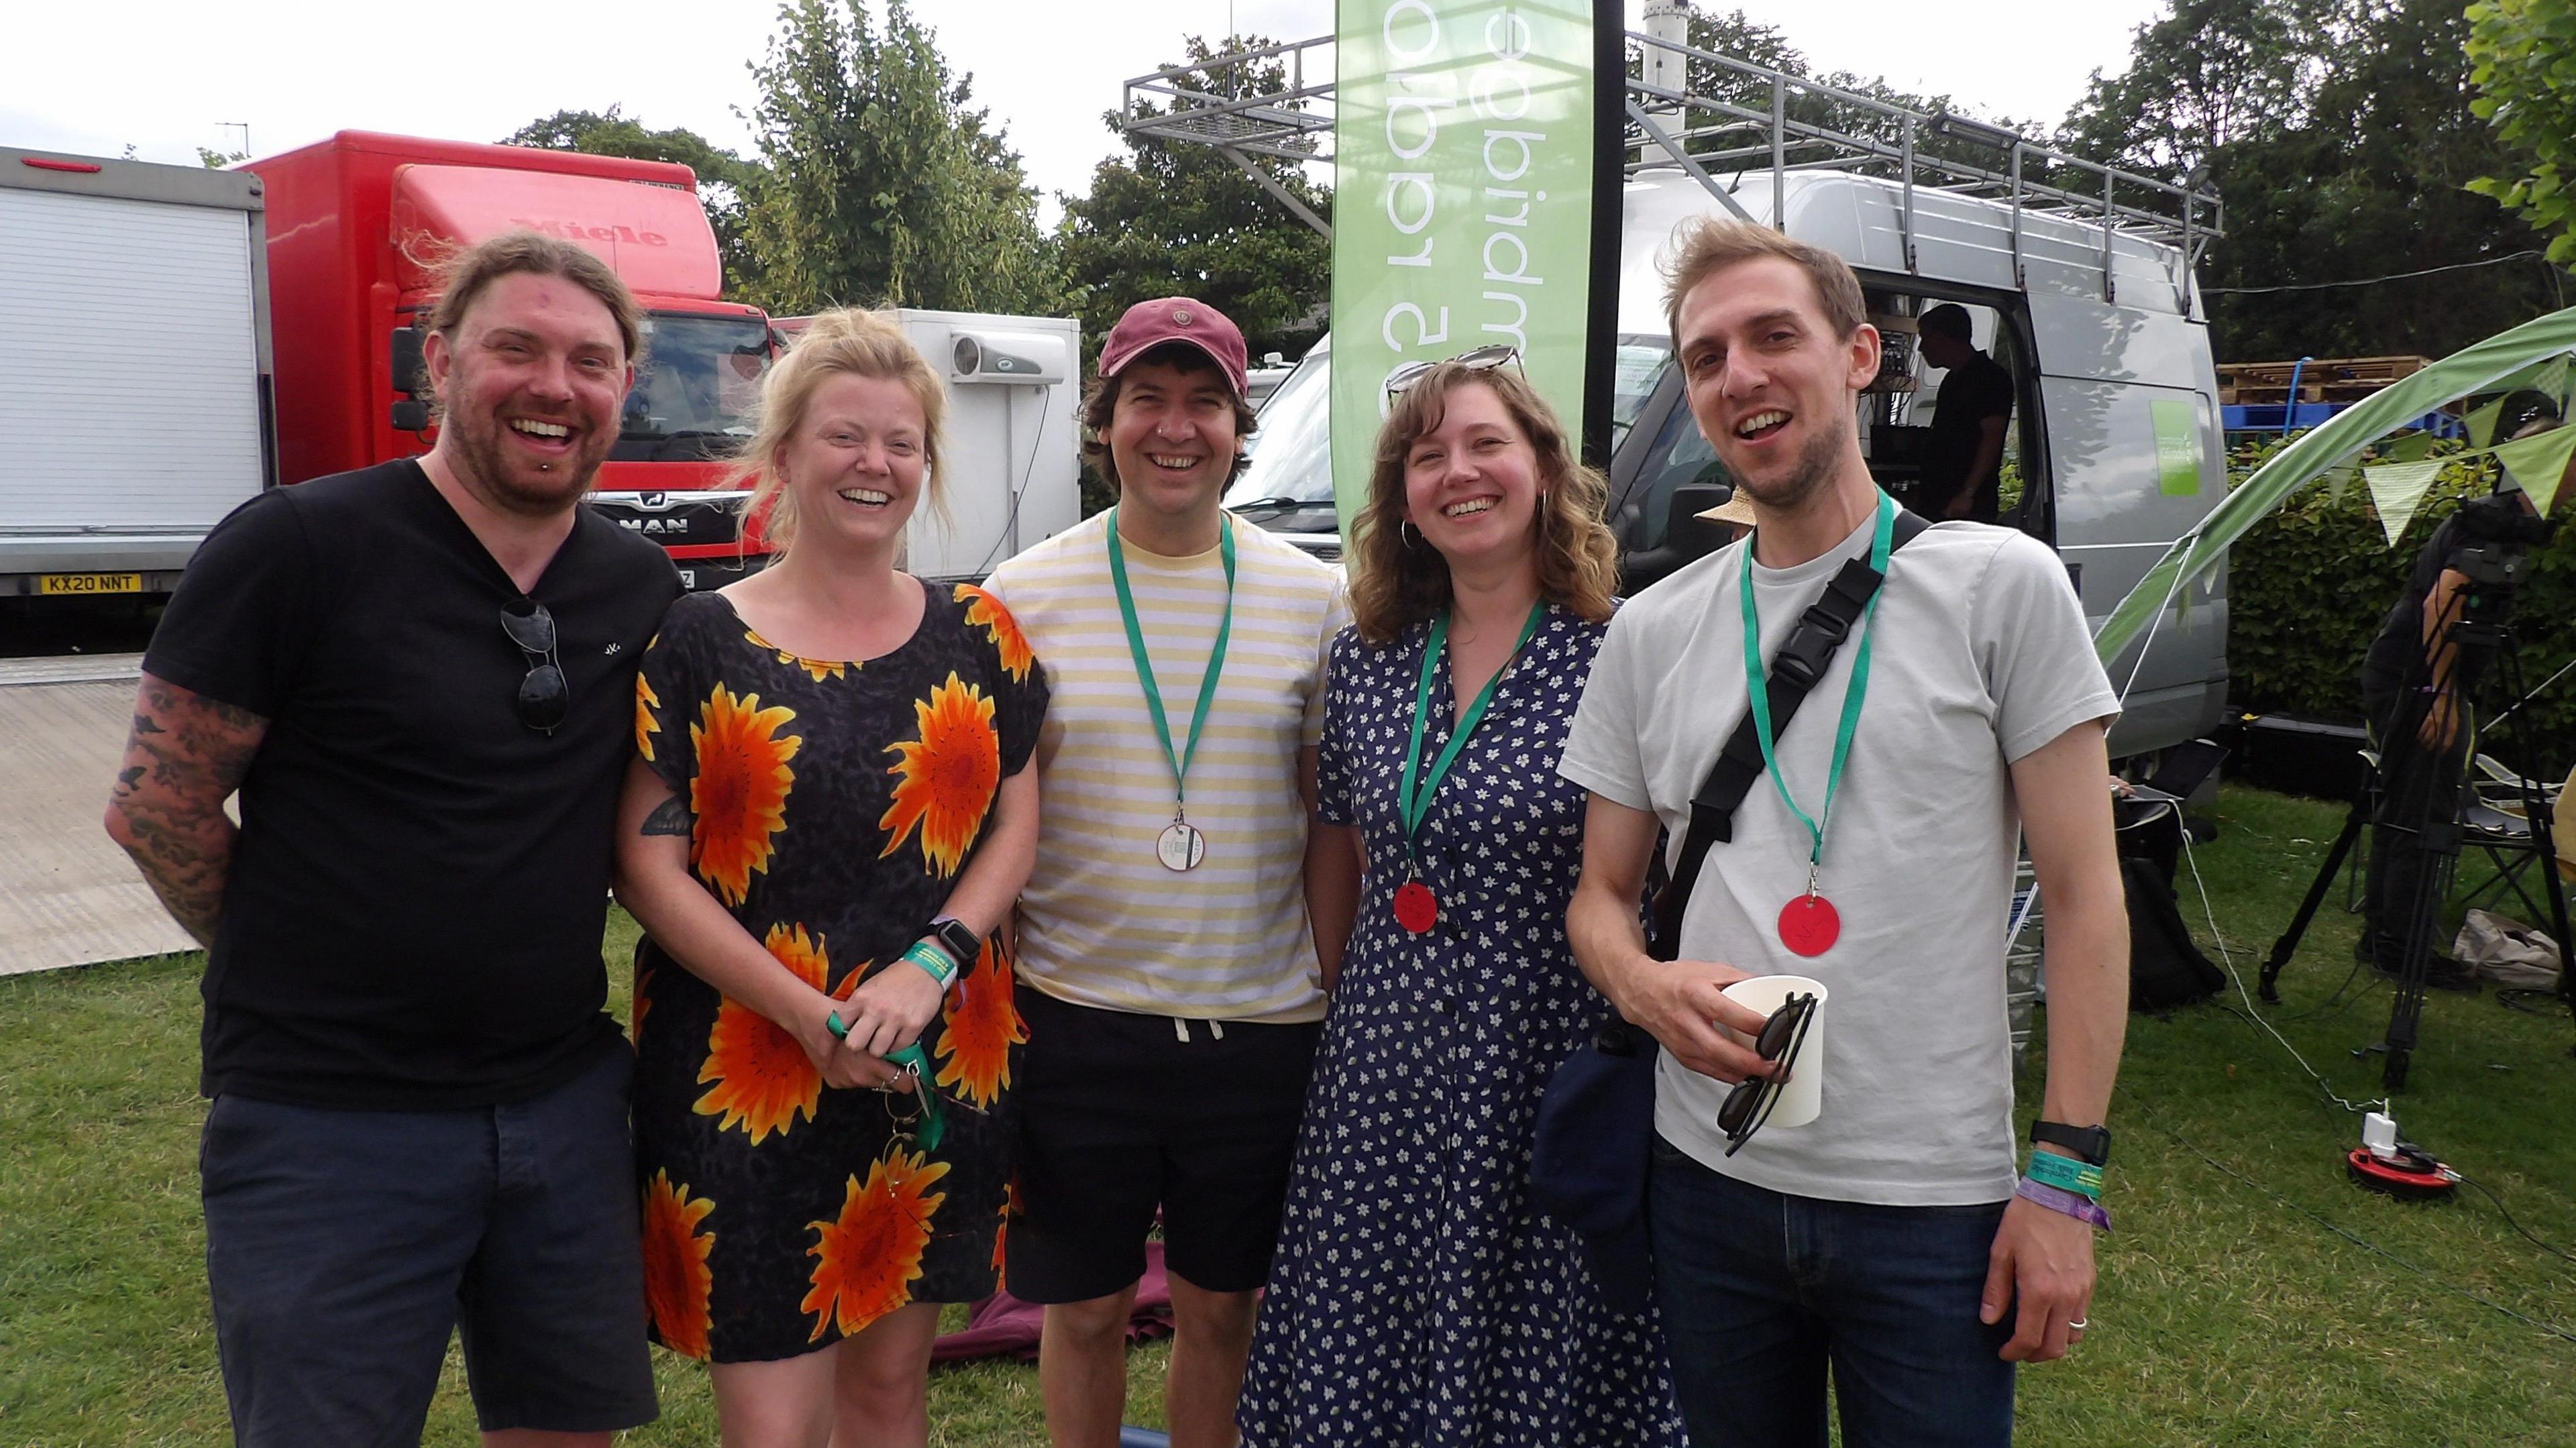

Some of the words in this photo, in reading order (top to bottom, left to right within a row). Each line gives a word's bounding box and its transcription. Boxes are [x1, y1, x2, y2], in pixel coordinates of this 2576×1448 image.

[510, 218, 668, 247] Miele
[619, 518, 688, 534] MAN
[49, 577, 95, 591] KX20
[100, 575, 132, 590] NNT
[682, 573, 691, 586] Z
